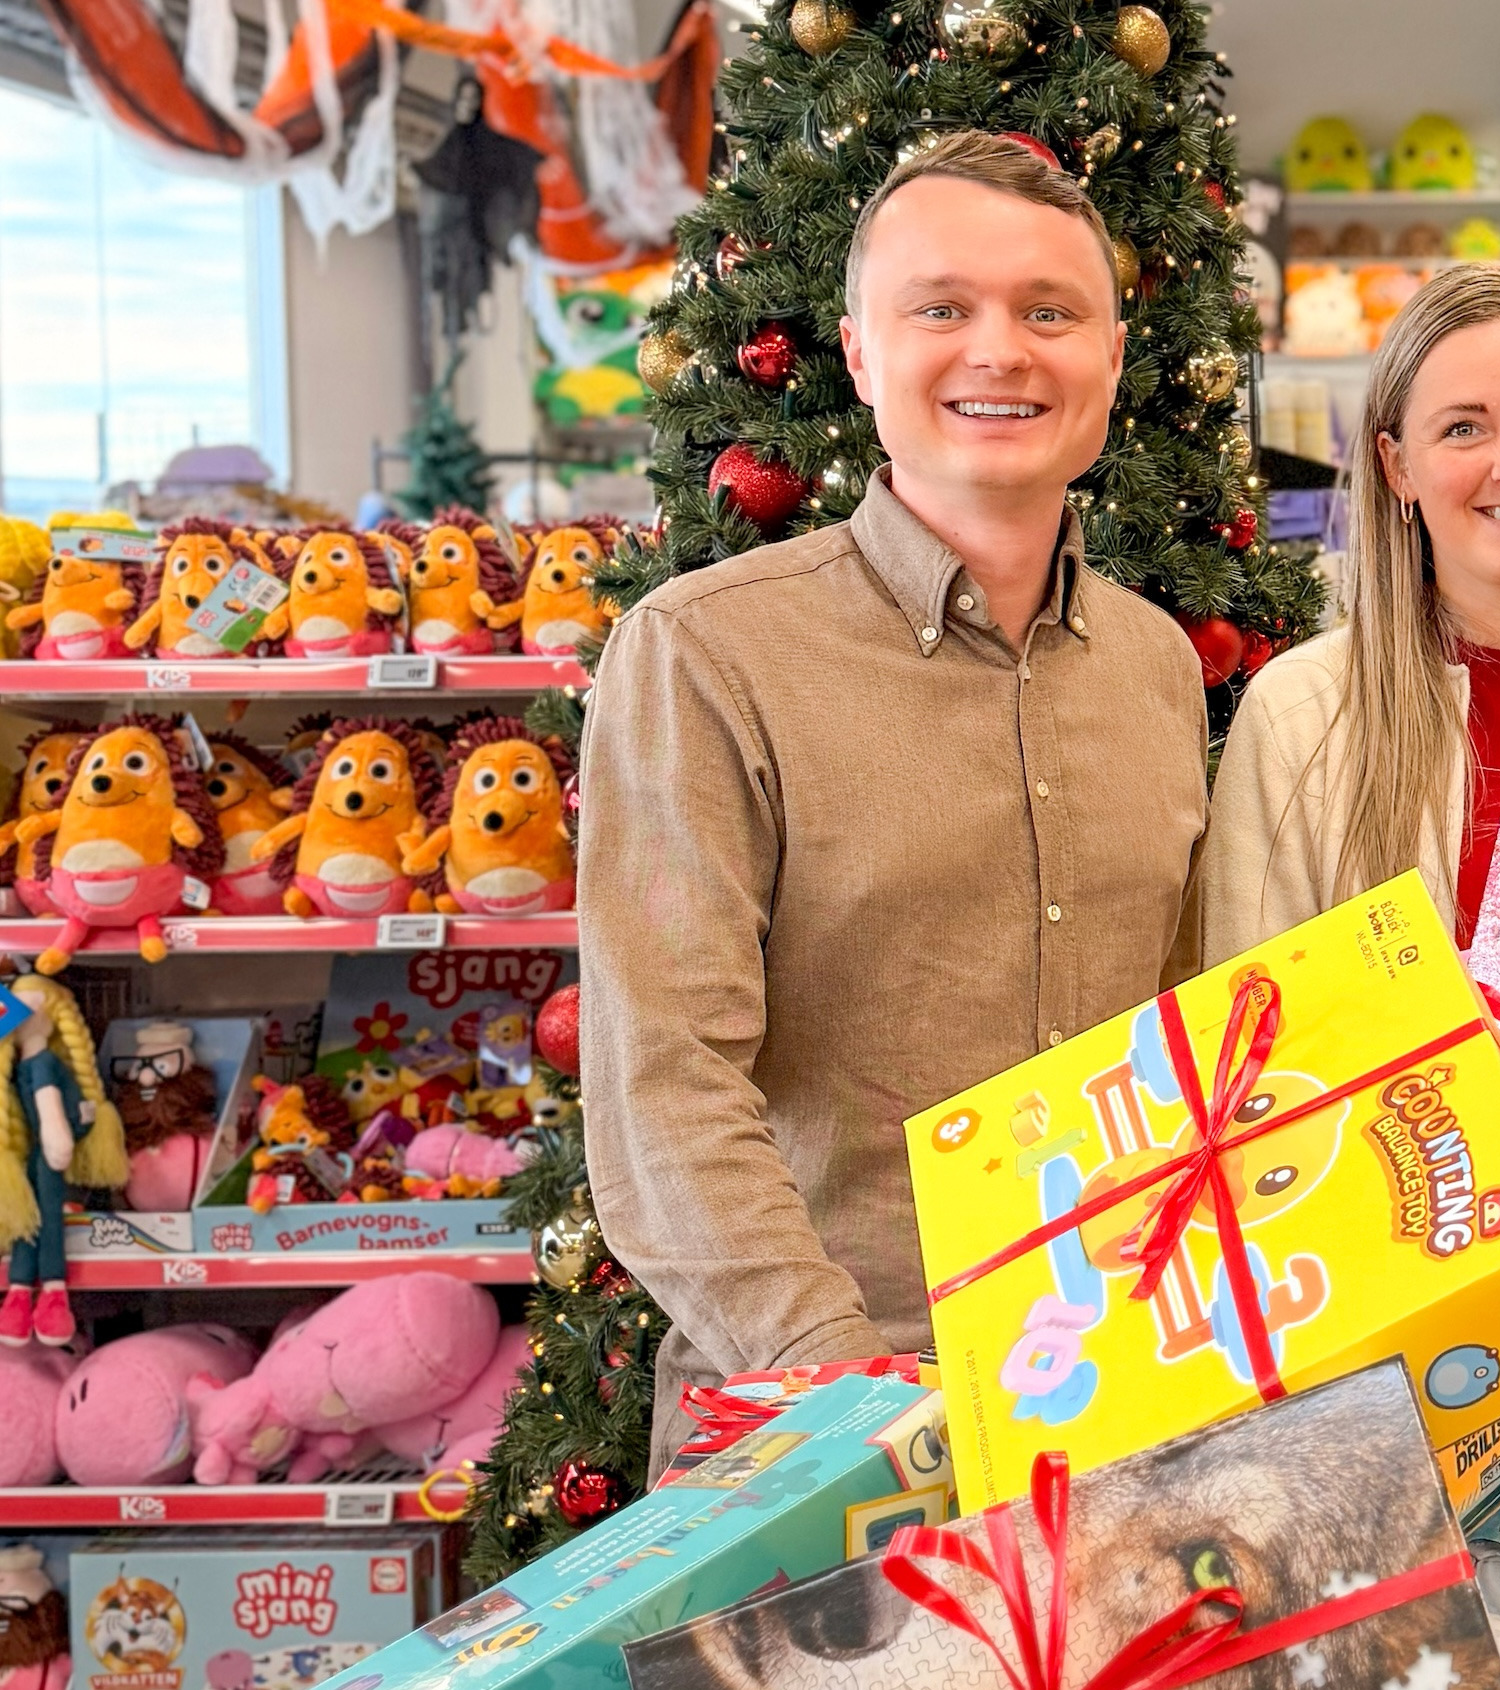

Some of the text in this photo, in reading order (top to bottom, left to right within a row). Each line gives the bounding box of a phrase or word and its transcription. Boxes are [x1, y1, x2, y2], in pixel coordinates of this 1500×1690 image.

[415, 954, 557, 1003] sjang
[1375, 1116, 1425, 1236] BALANCE TOY
[1382, 1073, 1478, 1258] COUNTING
[275, 1213, 431, 1251] Barnevogns-
[358, 1227, 449, 1250] bamser
[976, 1426, 994, 1476] PRODUCTS
[237, 1562, 334, 1600] mini
[235, 1599, 336, 1637] sjang
